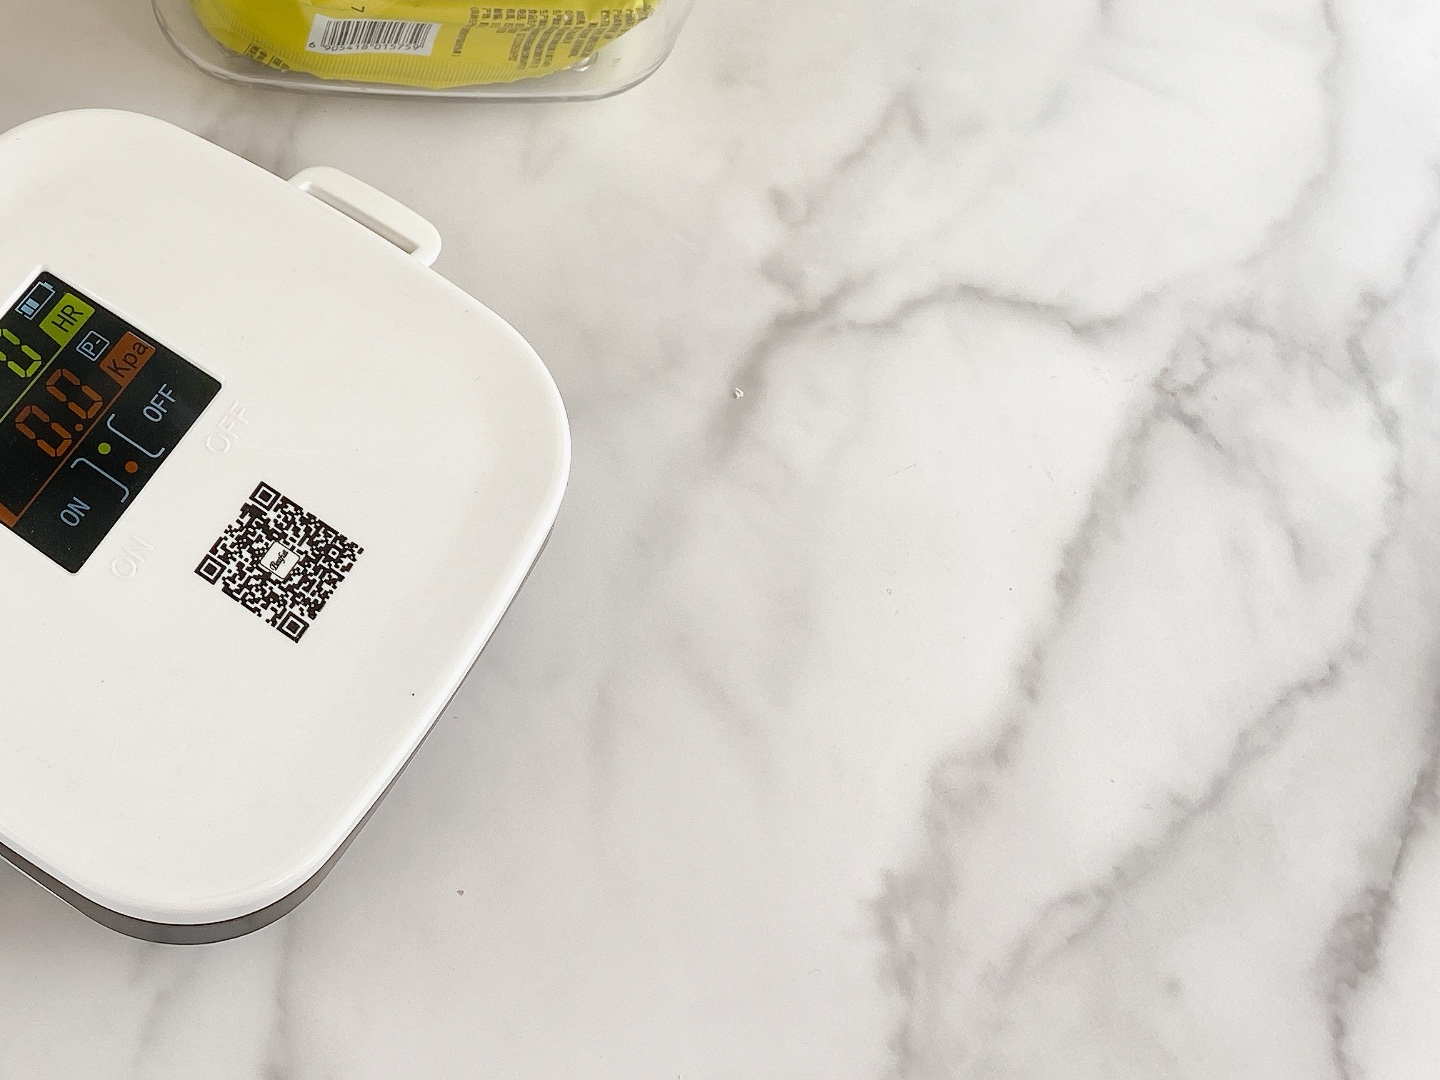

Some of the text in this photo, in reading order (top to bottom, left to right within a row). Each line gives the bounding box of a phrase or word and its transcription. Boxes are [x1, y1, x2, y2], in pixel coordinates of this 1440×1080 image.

[51, 302, 84, 334] HR
[15, 341, 150, 458] 0.0 Kpa
[205, 400, 252, 455] OFF
[60, 383, 177, 528] ON OFF
